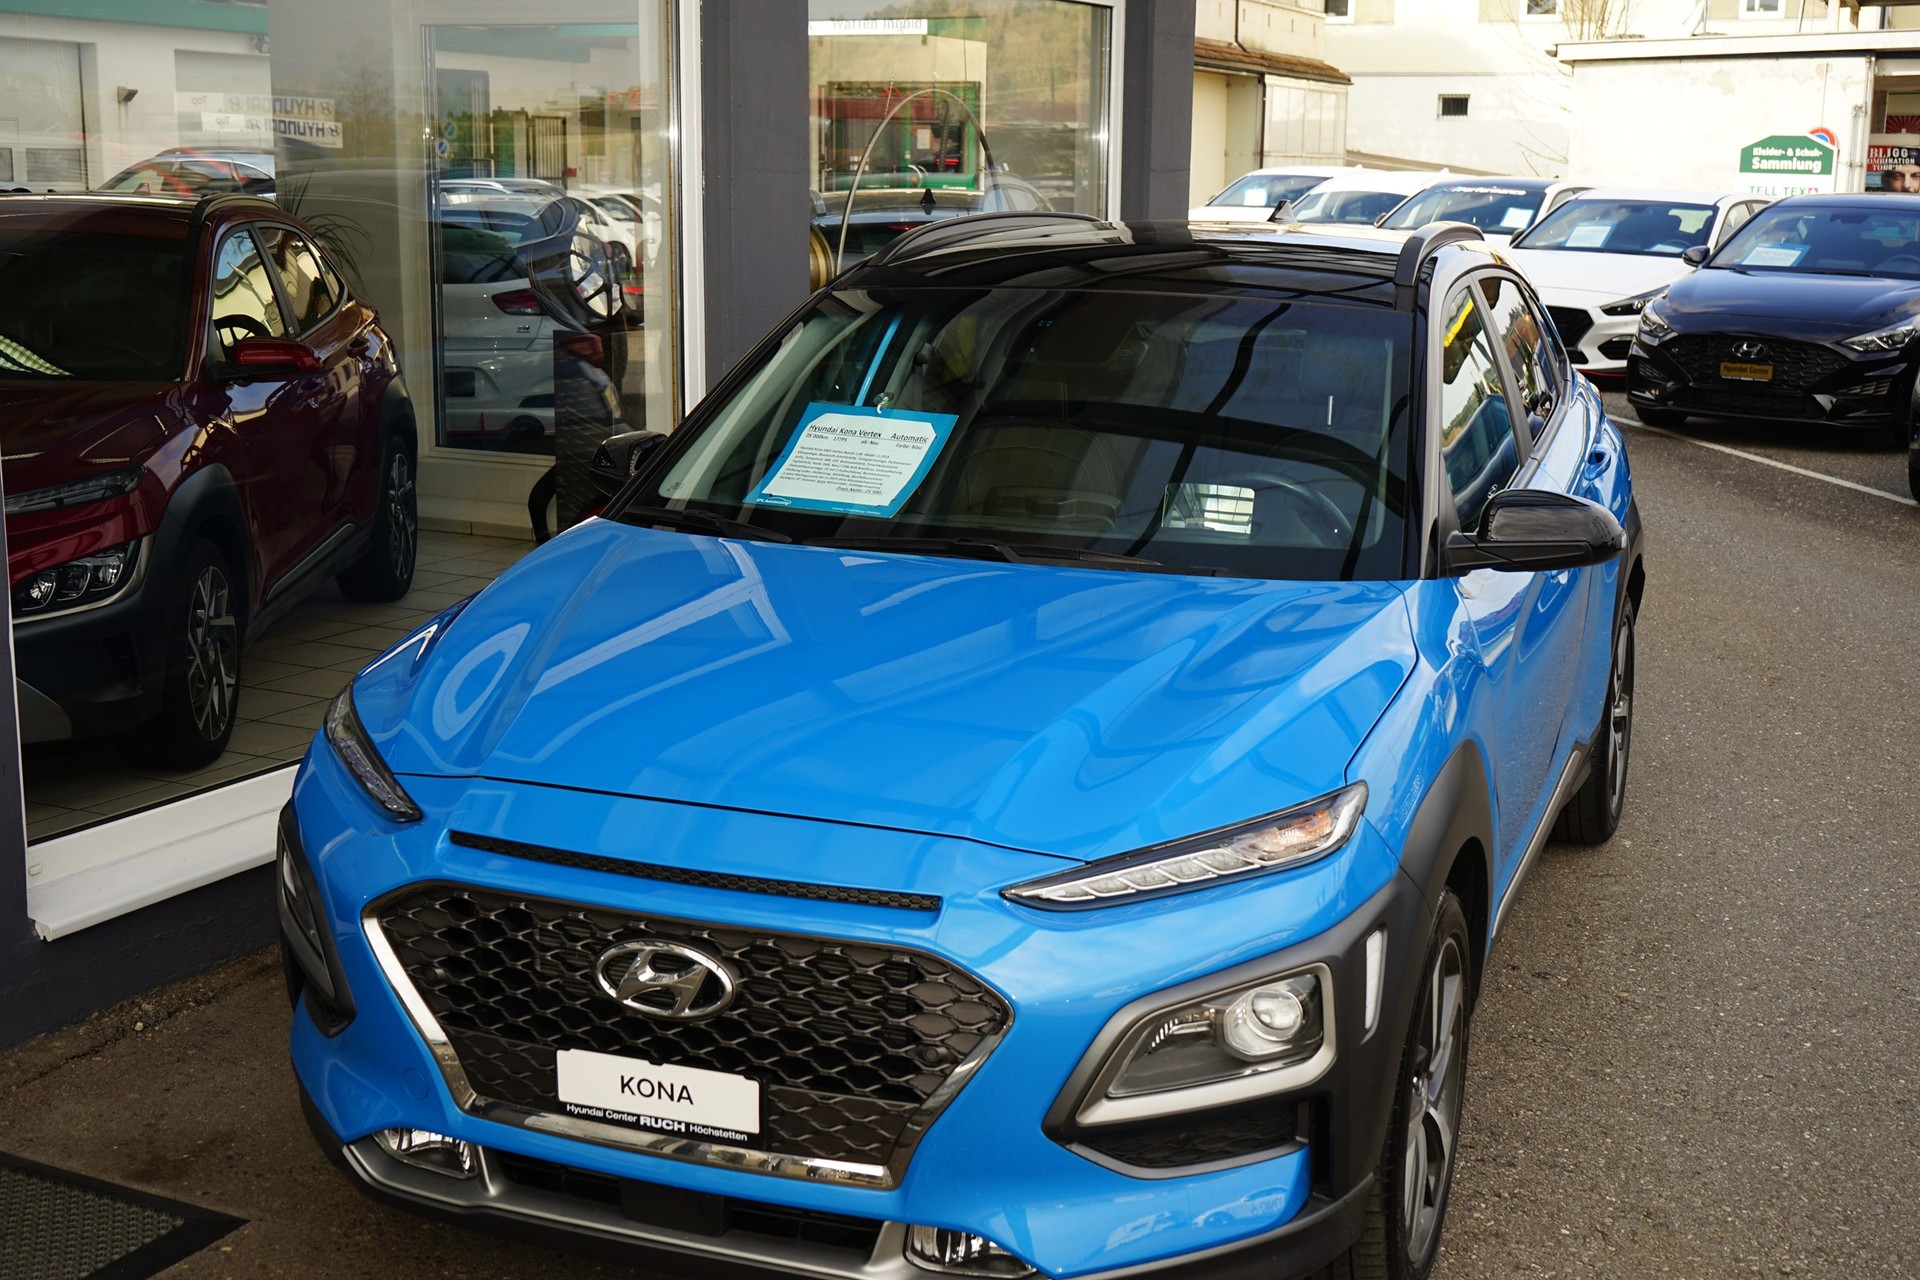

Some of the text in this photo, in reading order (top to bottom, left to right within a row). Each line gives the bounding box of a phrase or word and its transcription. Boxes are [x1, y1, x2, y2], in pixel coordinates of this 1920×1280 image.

[1752, 147, 1823, 157] Kleider- & Schuh-
[1752, 156, 1822, 174] Sammlung
[808, 424, 929, 443] Hyundai Kona Vertex Automatic
[620, 1074, 694, 1105] KONA
[566, 1104, 748, 1142] Hyundai Center RUCH Höchstetten
